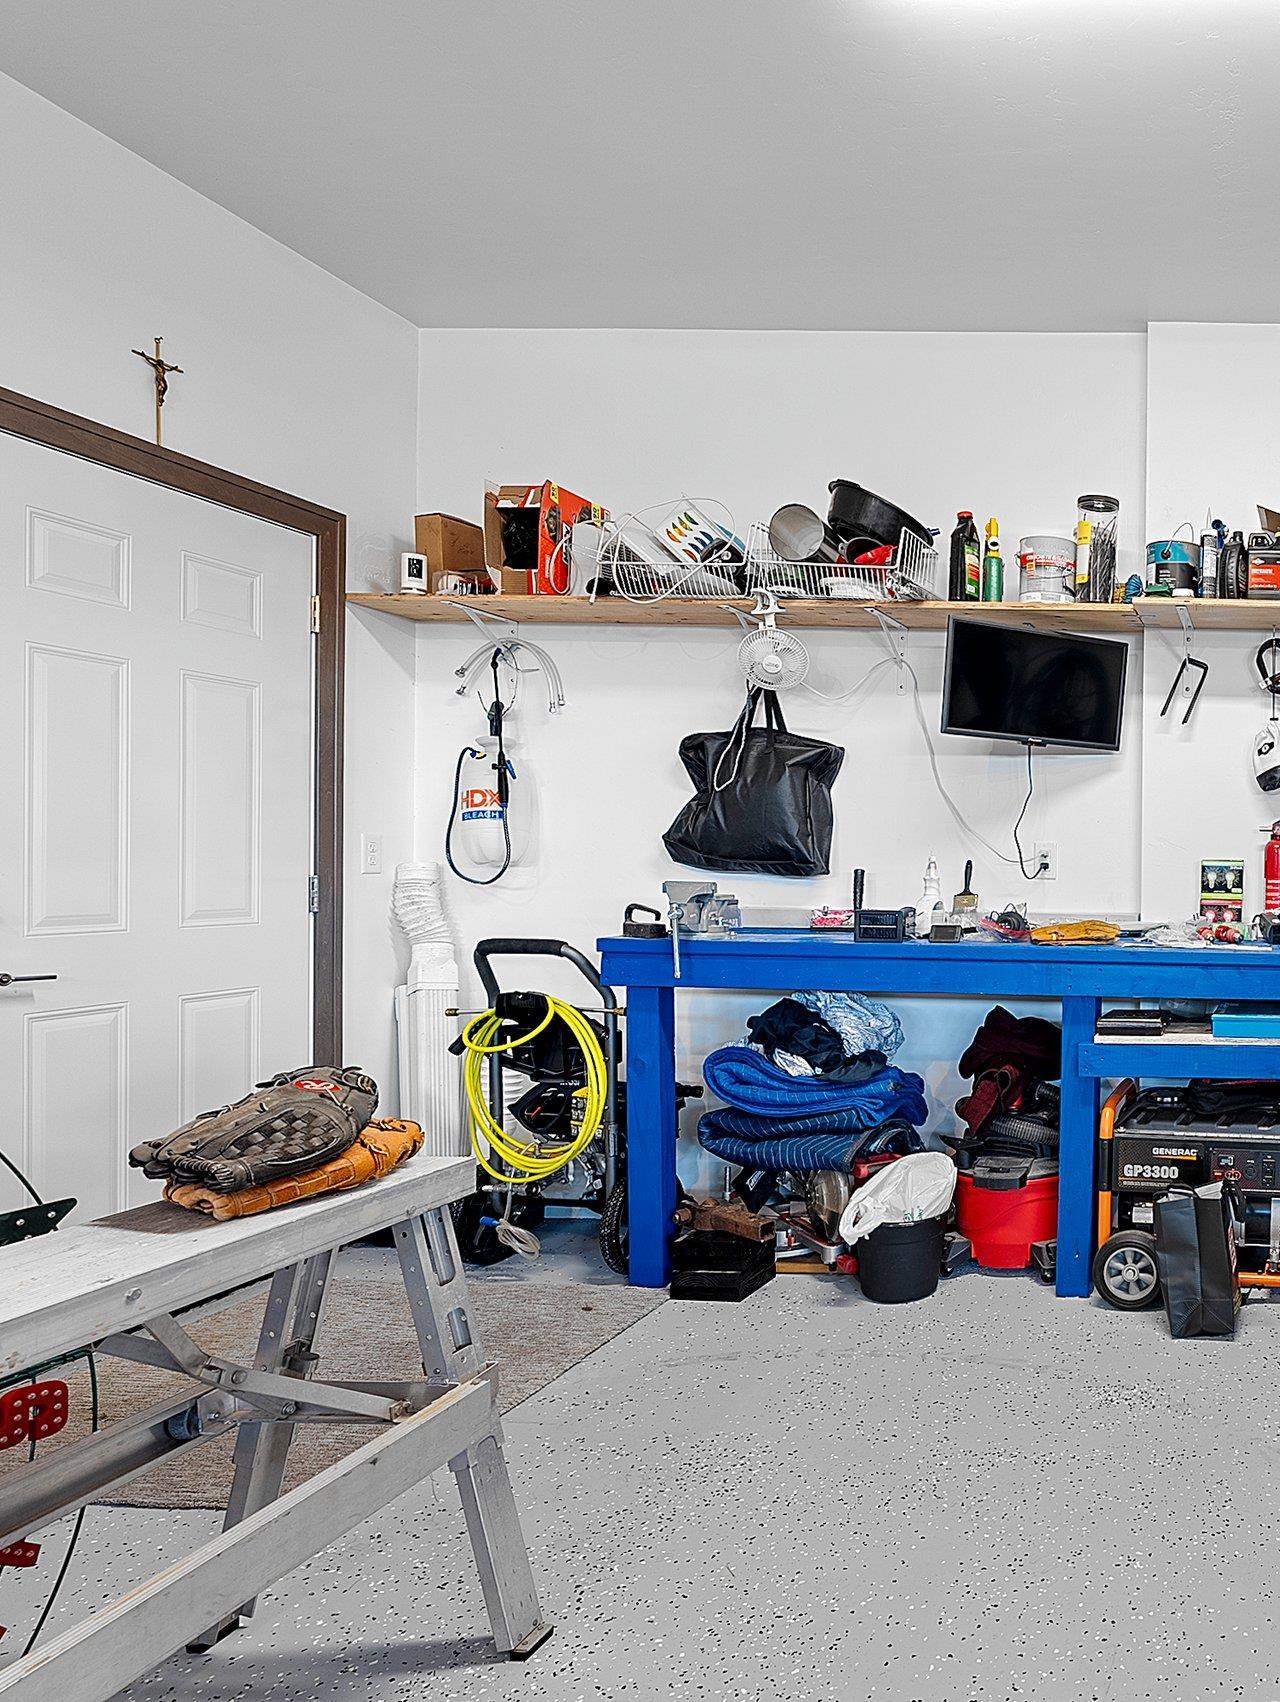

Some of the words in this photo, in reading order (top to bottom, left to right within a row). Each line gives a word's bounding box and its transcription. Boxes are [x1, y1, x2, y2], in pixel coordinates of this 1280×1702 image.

[461, 789, 501, 809] HDX
[463, 810, 499, 820] BLEACH
[1152, 1147, 1197, 1156] GENERAC
[1123, 1164, 1179, 1179] GP3300
